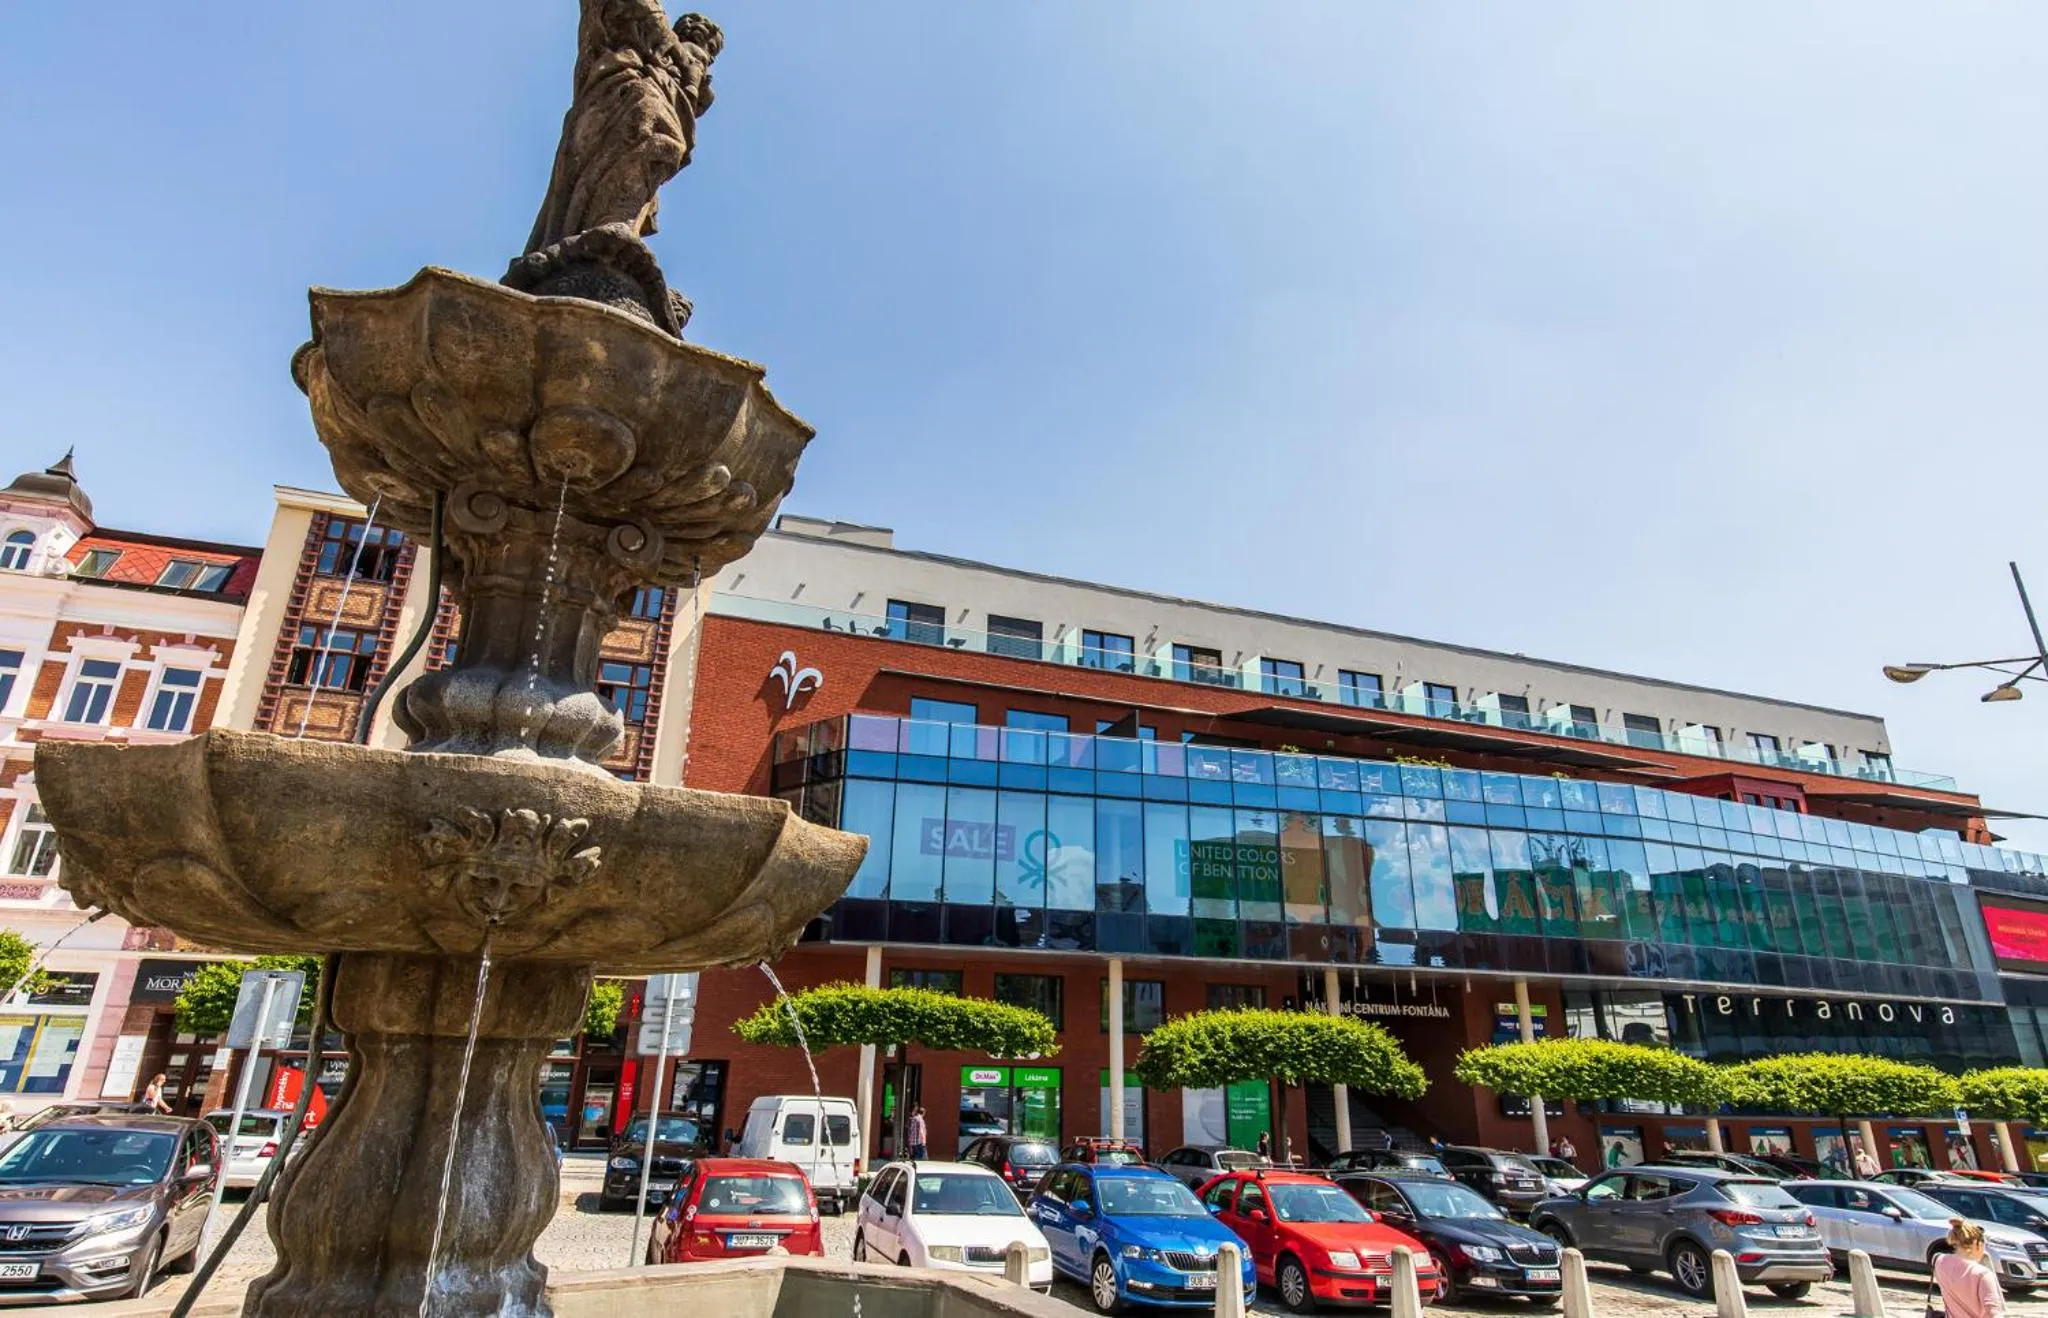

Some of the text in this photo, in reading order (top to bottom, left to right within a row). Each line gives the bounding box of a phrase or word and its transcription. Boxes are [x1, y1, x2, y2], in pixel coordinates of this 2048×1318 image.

[929, 826, 1008, 855] SALE
[1178, 842, 1296, 866] UNITED COLORS
[1178, 862, 1278, 881] OF BENTTON
[1353, 1003, 1400, 1016] CENTRUM
[1402, 1004, 1450, 1017] FONTÁNA
[1682, 994, 1956, 1025] Terranova
[2, 1265, 33, 1277] 2550
